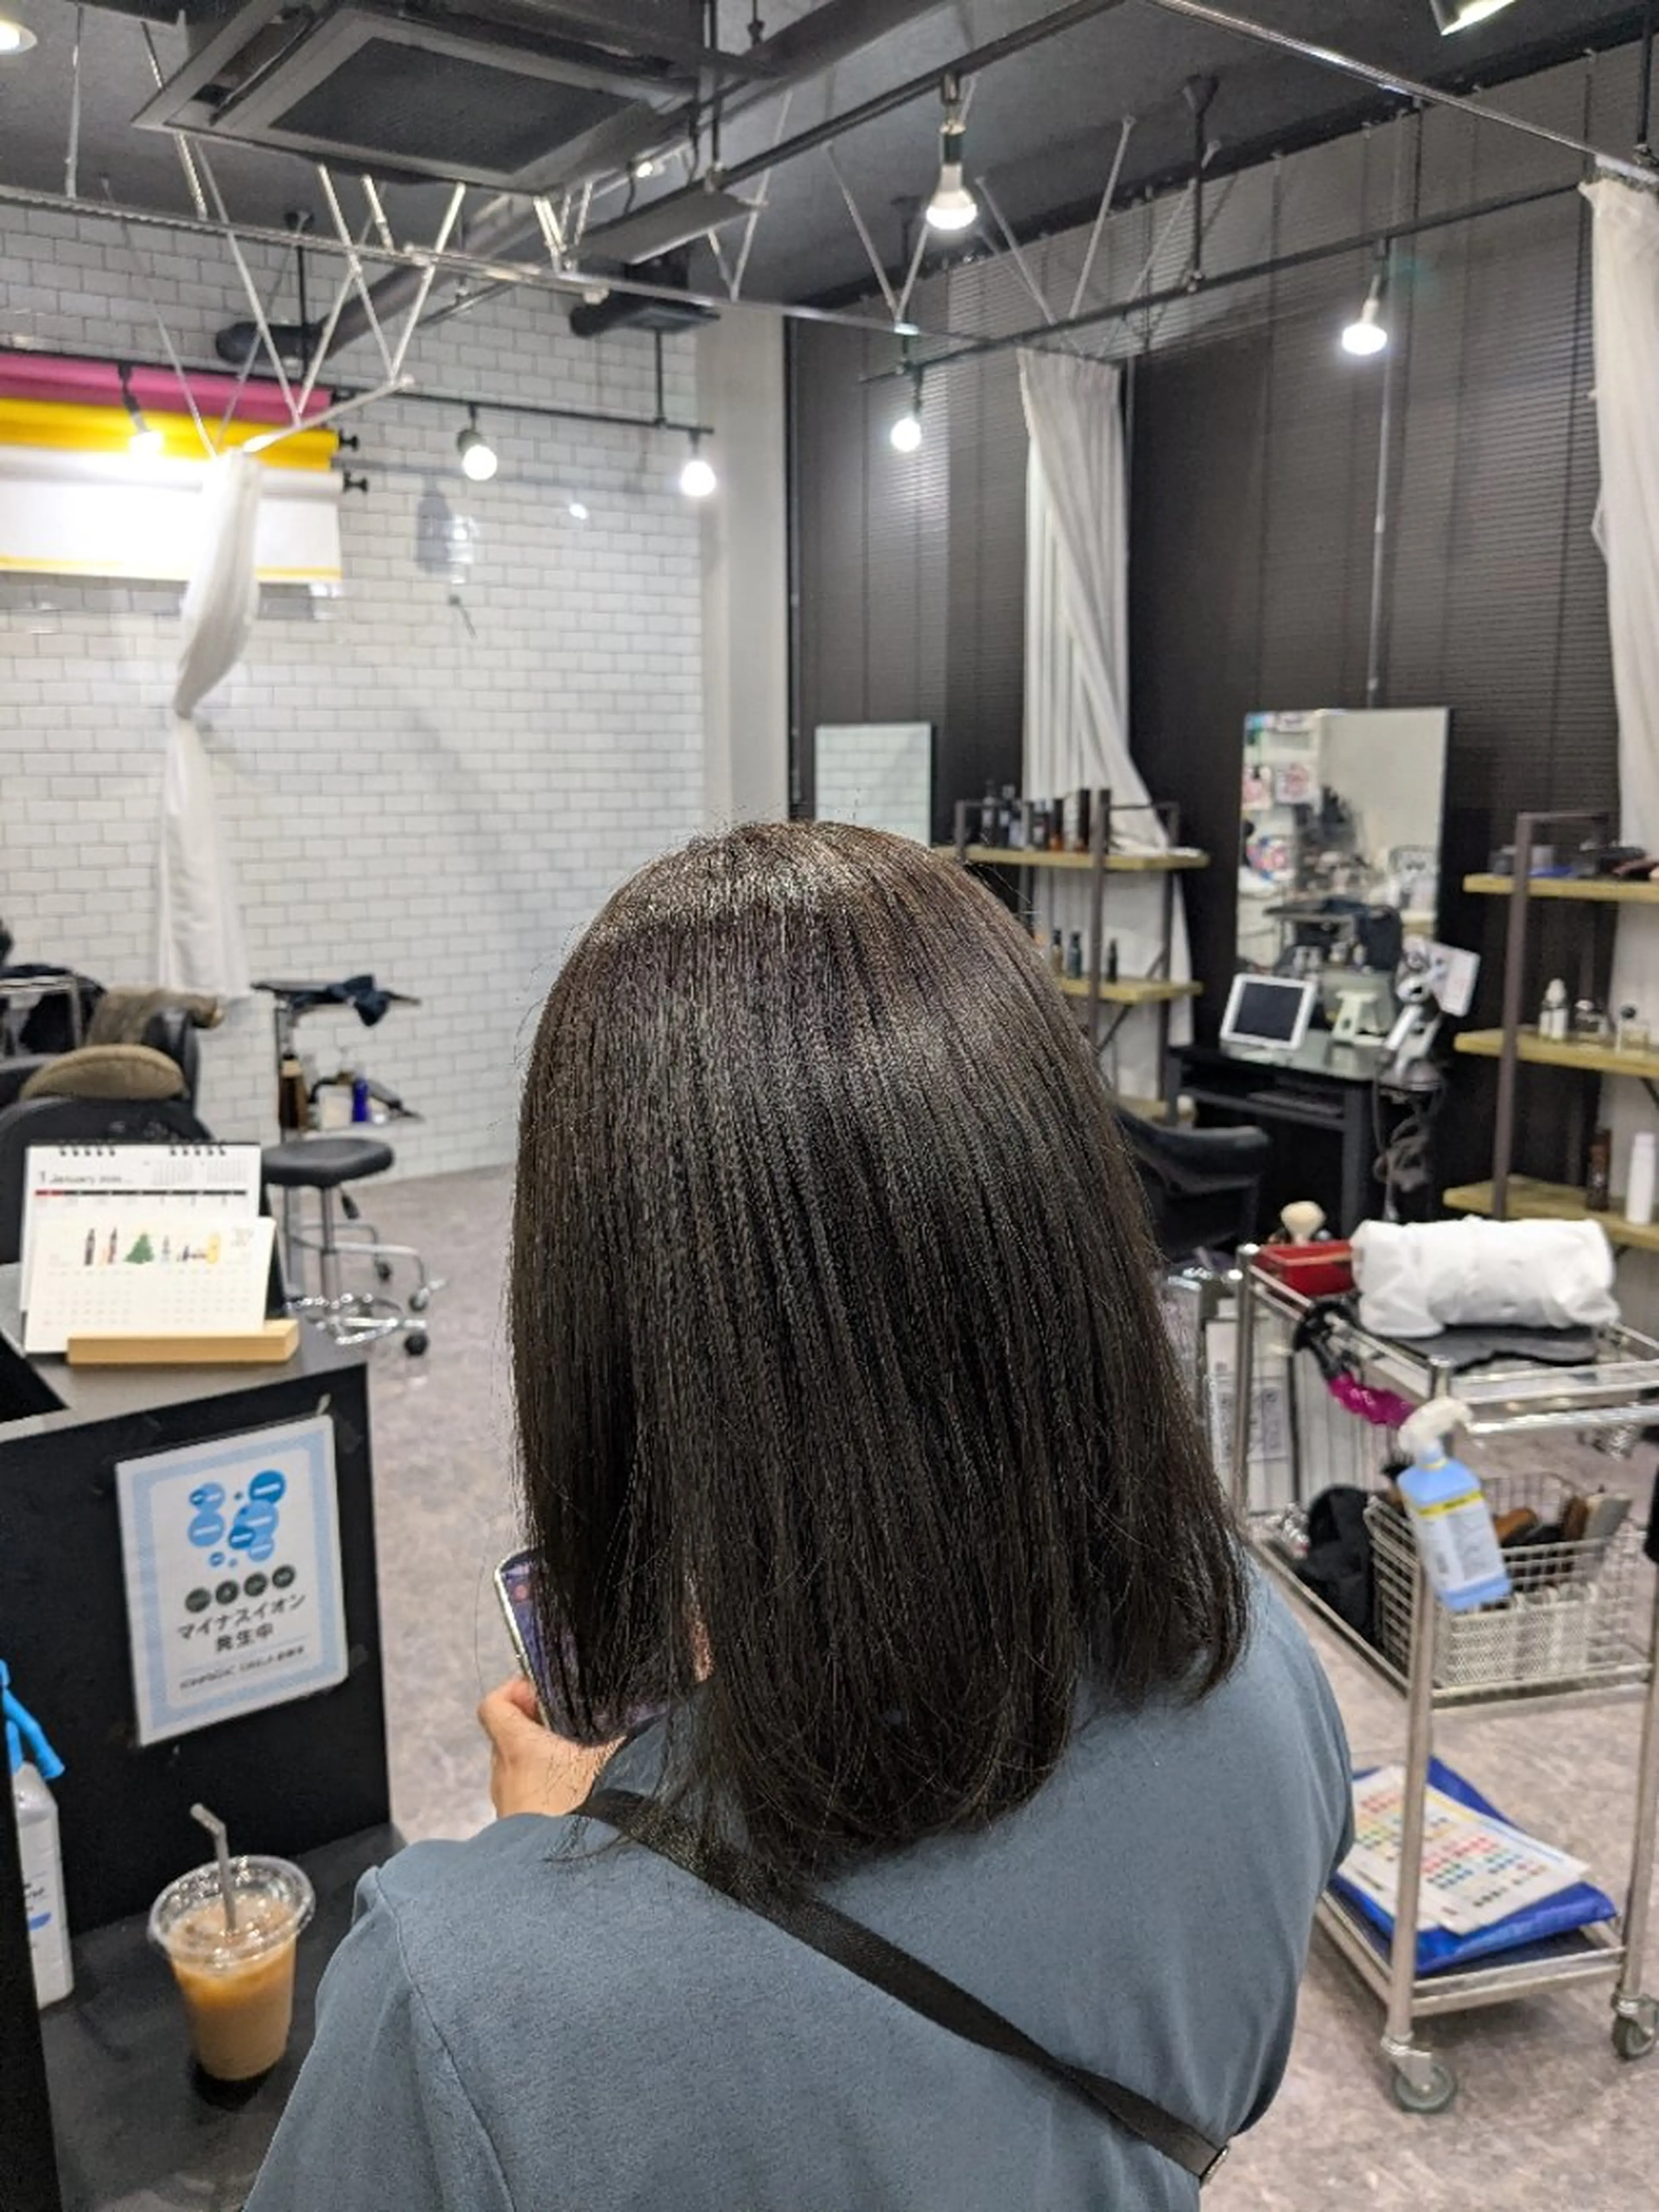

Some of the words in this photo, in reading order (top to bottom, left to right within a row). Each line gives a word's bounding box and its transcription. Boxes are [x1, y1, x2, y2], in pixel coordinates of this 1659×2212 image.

[177, 1594, 305, 1639] マイナスイオン
[216, 1622, 273, 1652] 発生中
